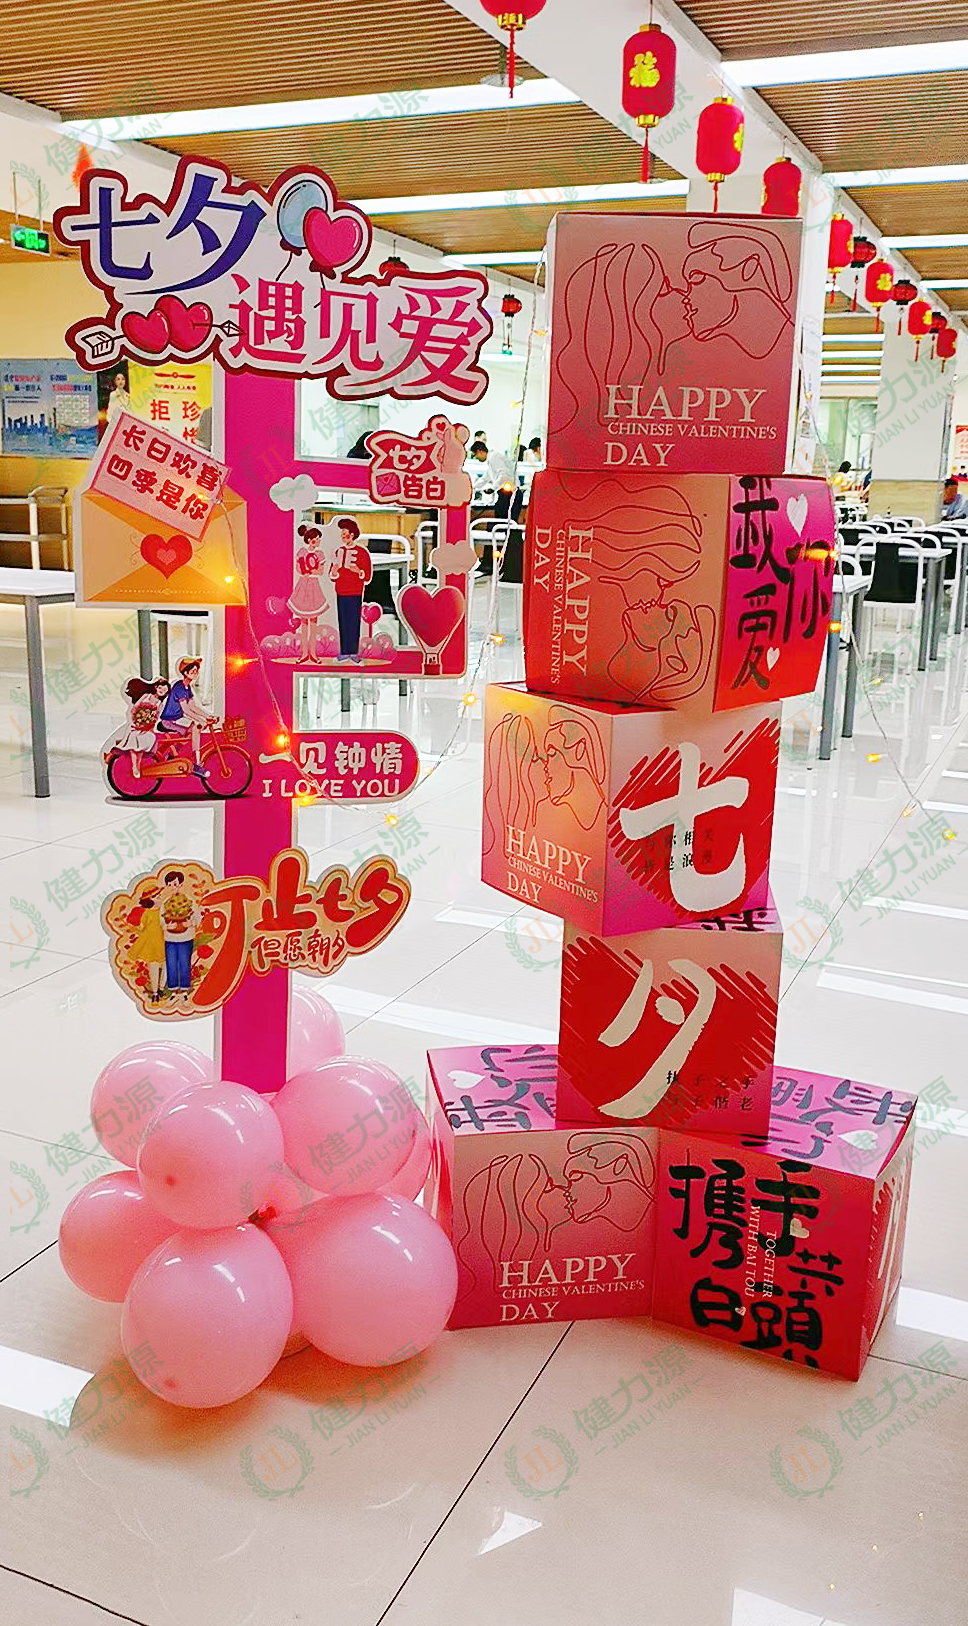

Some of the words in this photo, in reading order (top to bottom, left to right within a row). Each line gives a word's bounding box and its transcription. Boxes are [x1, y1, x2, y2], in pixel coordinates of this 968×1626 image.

[630, 51, 660, 87] 福
[71, 173, 267, 294] 七夕
[228, 273, 484, 392] 遇见爱
[151, 398, 170, 420] 拒
[603, 384, 767, 423] HAPPY
[607, 421, 674, 437] CHINESE
[677, 424, 778, 440] VALENTINE'S
[121, 425, 222, 493] 长日欢喜
[389, 444, 427, 469] 七夕
[603, 441, 676, 467] DAY
[107, 453, 207, 522] 四季是你
[402, 474, 446, 500] 告白
[533, 525, 552, 593] DAY
[553, 529, 567, 592] CHINESE
[562, 525, 594, 675] HAPPY
[549, 593, 563, 684] VALENTINE'S
[259, 740, 403, 775] 一见钟情
[262, 779, 271, 797] I
[280, 778, 343, 798] LOVE
[352, 778, 400, 797] YOU
[619, 742, 749, 912] 七
[505, 824, 592, 884] HAPPY
[506, 871, 543, 904] DAY
[508, 855, 542, 880] CHINESE
[542, 870, 598, 903] VALENTINE'S
[250, 928, 345, 969] 但愿朝夕
[598, 959, 716, 1121] 夕
[748, 1205, 761, 1243] WITH
[499, 1252, 637, 1288] HAPPY
[746, 1243, 758, 1267] BAI
[762, 1230, 777, 1298] TOGETHER
[501, 1284, 559, 1299] CHINESE
[562, 1278, 645, 1296] VALENTINE'S
[744, 1270, 757, 1298] TOU
[500, 1300, 560, 1322] DAY
